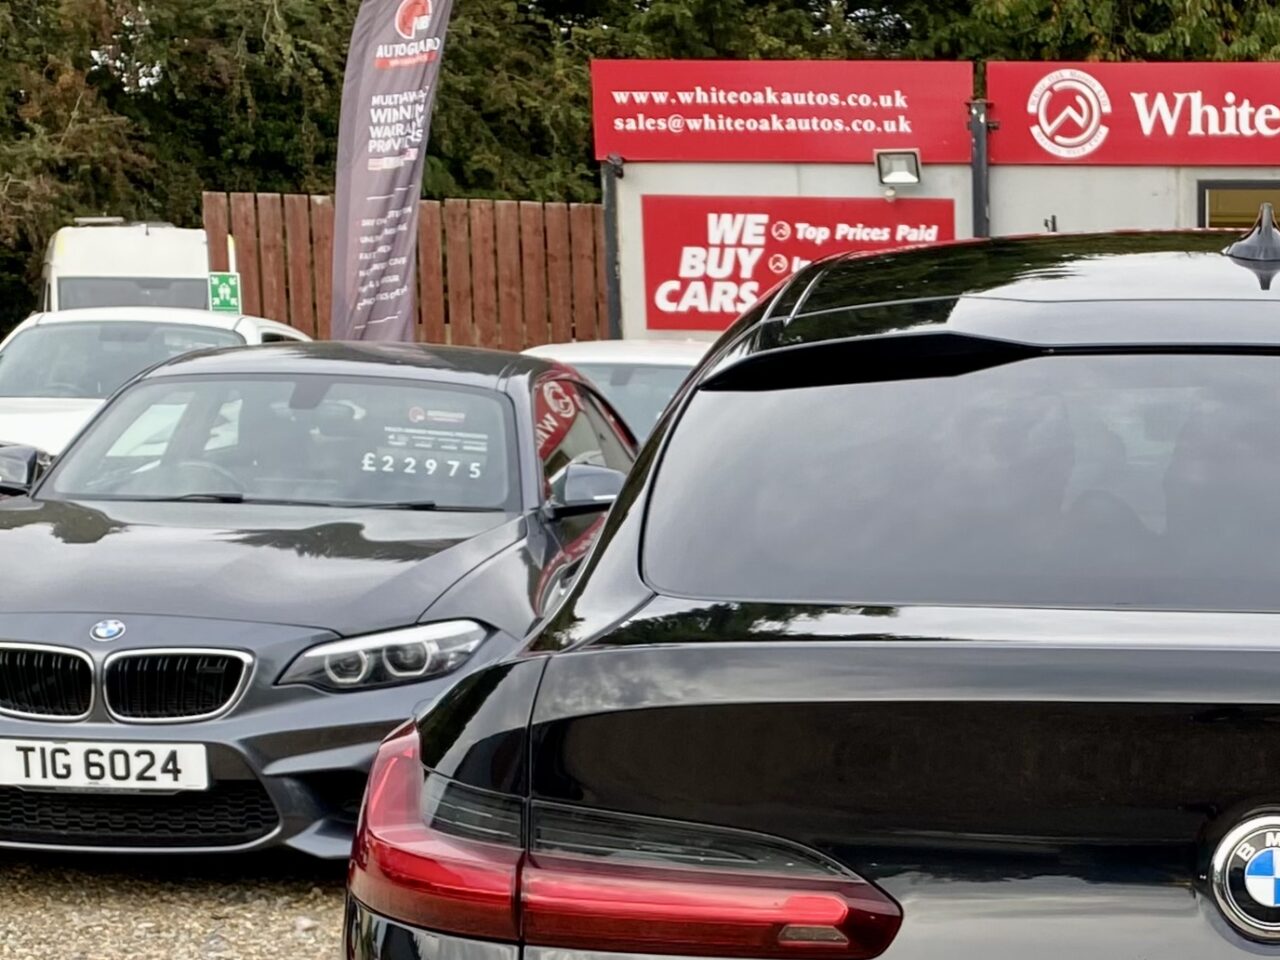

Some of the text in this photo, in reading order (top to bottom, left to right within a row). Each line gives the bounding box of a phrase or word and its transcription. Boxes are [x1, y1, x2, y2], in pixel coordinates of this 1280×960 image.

[611, 86, 908, 109] www.whiteoakautos.co.uk
[613, 113, 912, 134] sales@whiteoakautos.co.uk
[707, 213, 770, 246] WE
[795, 222, 939, 246] Top Prices Paid
[678, 247, 765, 280] BUY
[655, 280, 760, 314] CARS
[361, 452, 482, 479] £22975
[15, 746, 182, 782] TIG 6024
